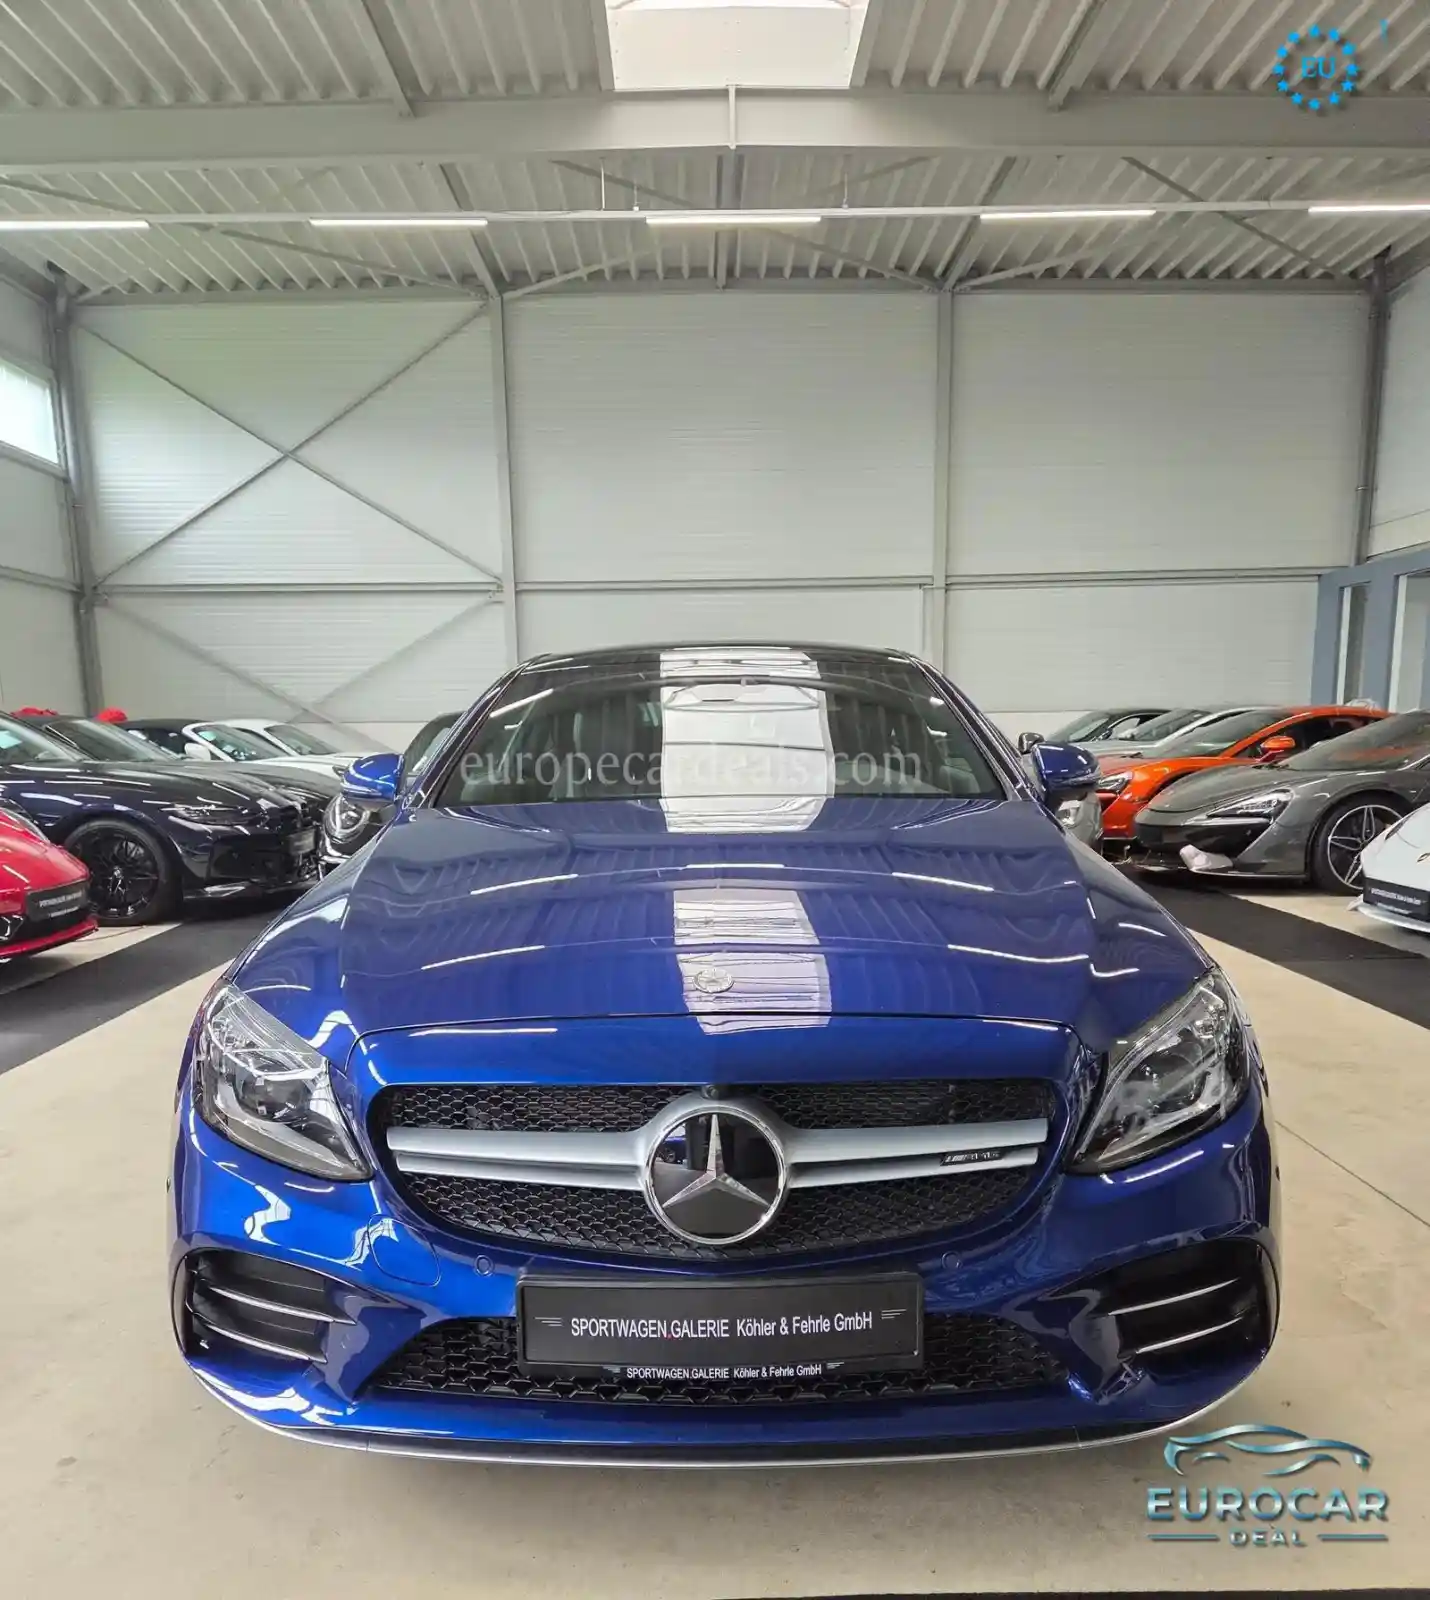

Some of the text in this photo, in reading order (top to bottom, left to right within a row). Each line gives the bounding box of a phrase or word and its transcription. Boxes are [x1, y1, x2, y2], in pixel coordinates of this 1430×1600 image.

[736, 1317, 777, 1338] Köhler
[779, 1316, 789, 1336] &
[792, 1311, 831, 1335] Fehrle
[833, 1311, 873, 1332] GmbH
[733, 1366, 760, 1379] Köhler
[761, 1366, 768, 1378] &
[769, 1364, 795, 1378] Fehrle
[796, 1363, 822, 1376] GmbH
